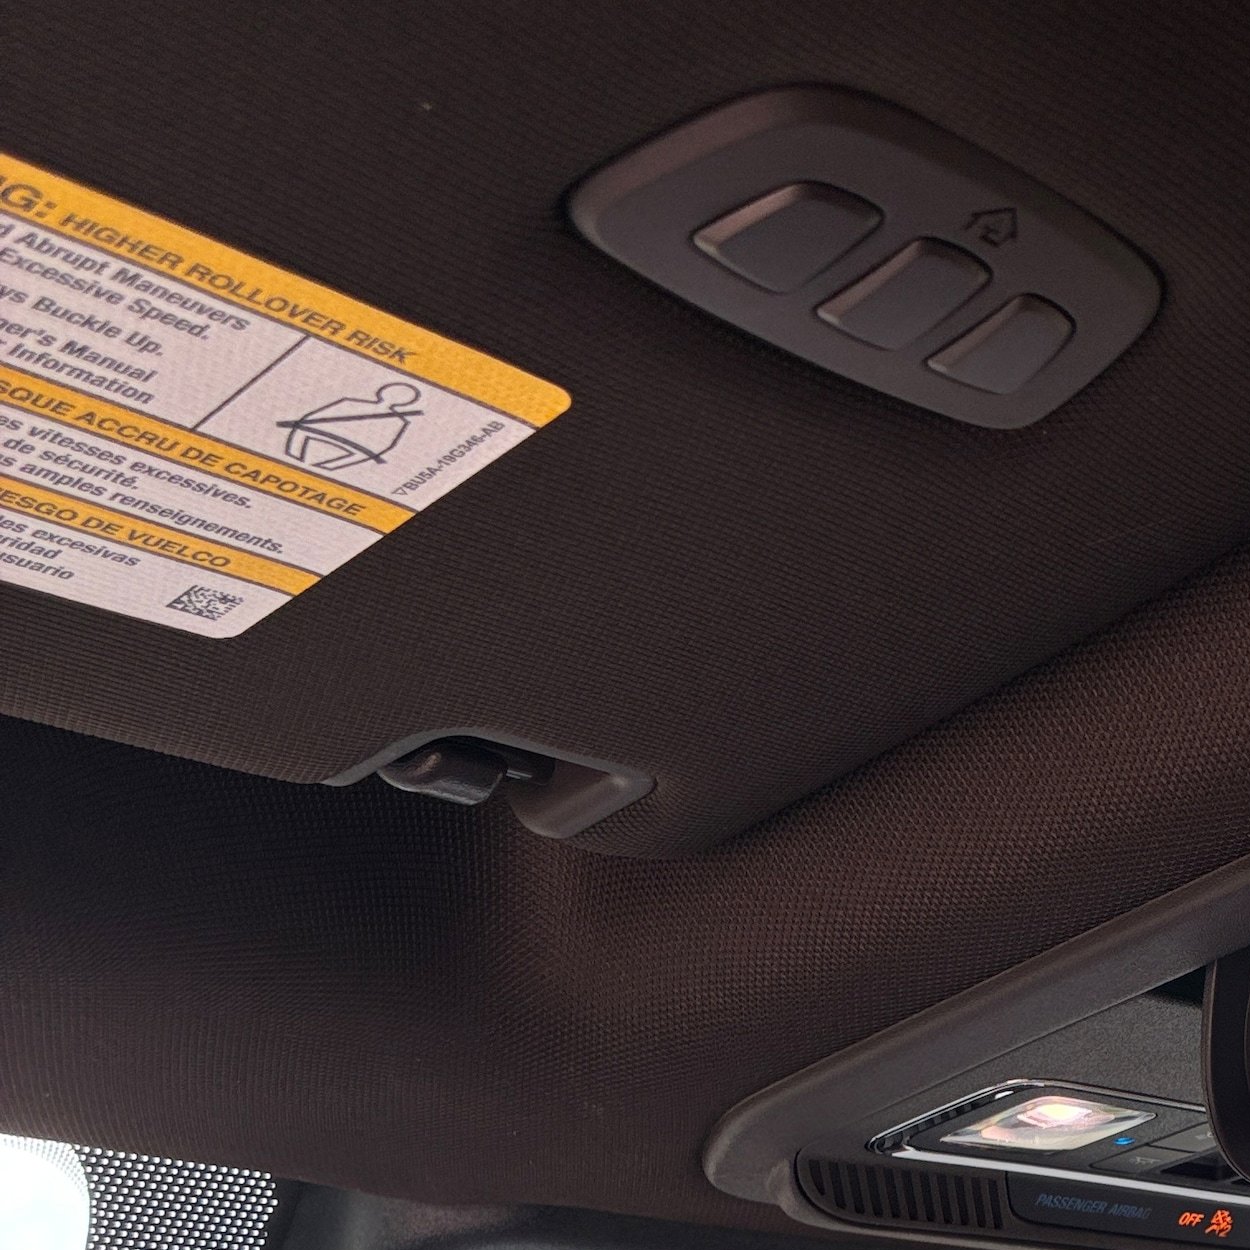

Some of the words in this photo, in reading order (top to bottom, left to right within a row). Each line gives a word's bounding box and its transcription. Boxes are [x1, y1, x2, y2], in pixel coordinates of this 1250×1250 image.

[0, 247, 126, 305] Excessive
[128, 298, 209, 340] Speed.
[15, 231, 108, 277] Abrupt
[110, 266, 250, 331] Maneuvers
[60, 212, 185, 270] HIGHER
[185, 264, 346, 336] ROLLOVER
[346, 328, 416, 364] RISK
[31, 296, 122, 338] Buckle
[124, 331, 163, 356] Up.
[60, 340, 158, 382] Manual
[8, 342, 154, 404] Information
[3, 439, 36, 454] de
[38, 450, 138, 490] sécurité.
[28, 424, 127, 466] vitesses
[129, 459, 251, 508] excessives.
[75, 411, 178, 452] ACCRU
[180, 446, 223, 468] DE
[224, 461, 366, 516] CAPOTAGE
[0, 487, 78, 522] ESGO
[81, 516, 124, 535] DE
[128, 530, 231, 568] VUELCO
[19, 463, 107, 497] amples
[109, 490, 283, 554] renseignements.
[0, 552, 75, 579] suario
[31, 529, 141, 567] excesivas
[1035, 1193, 1107, 1214] PASSENGER
[1108, 1203, 1152, 1219] AIRBAG
[1178, 1213, 1204, 1226] OFF
